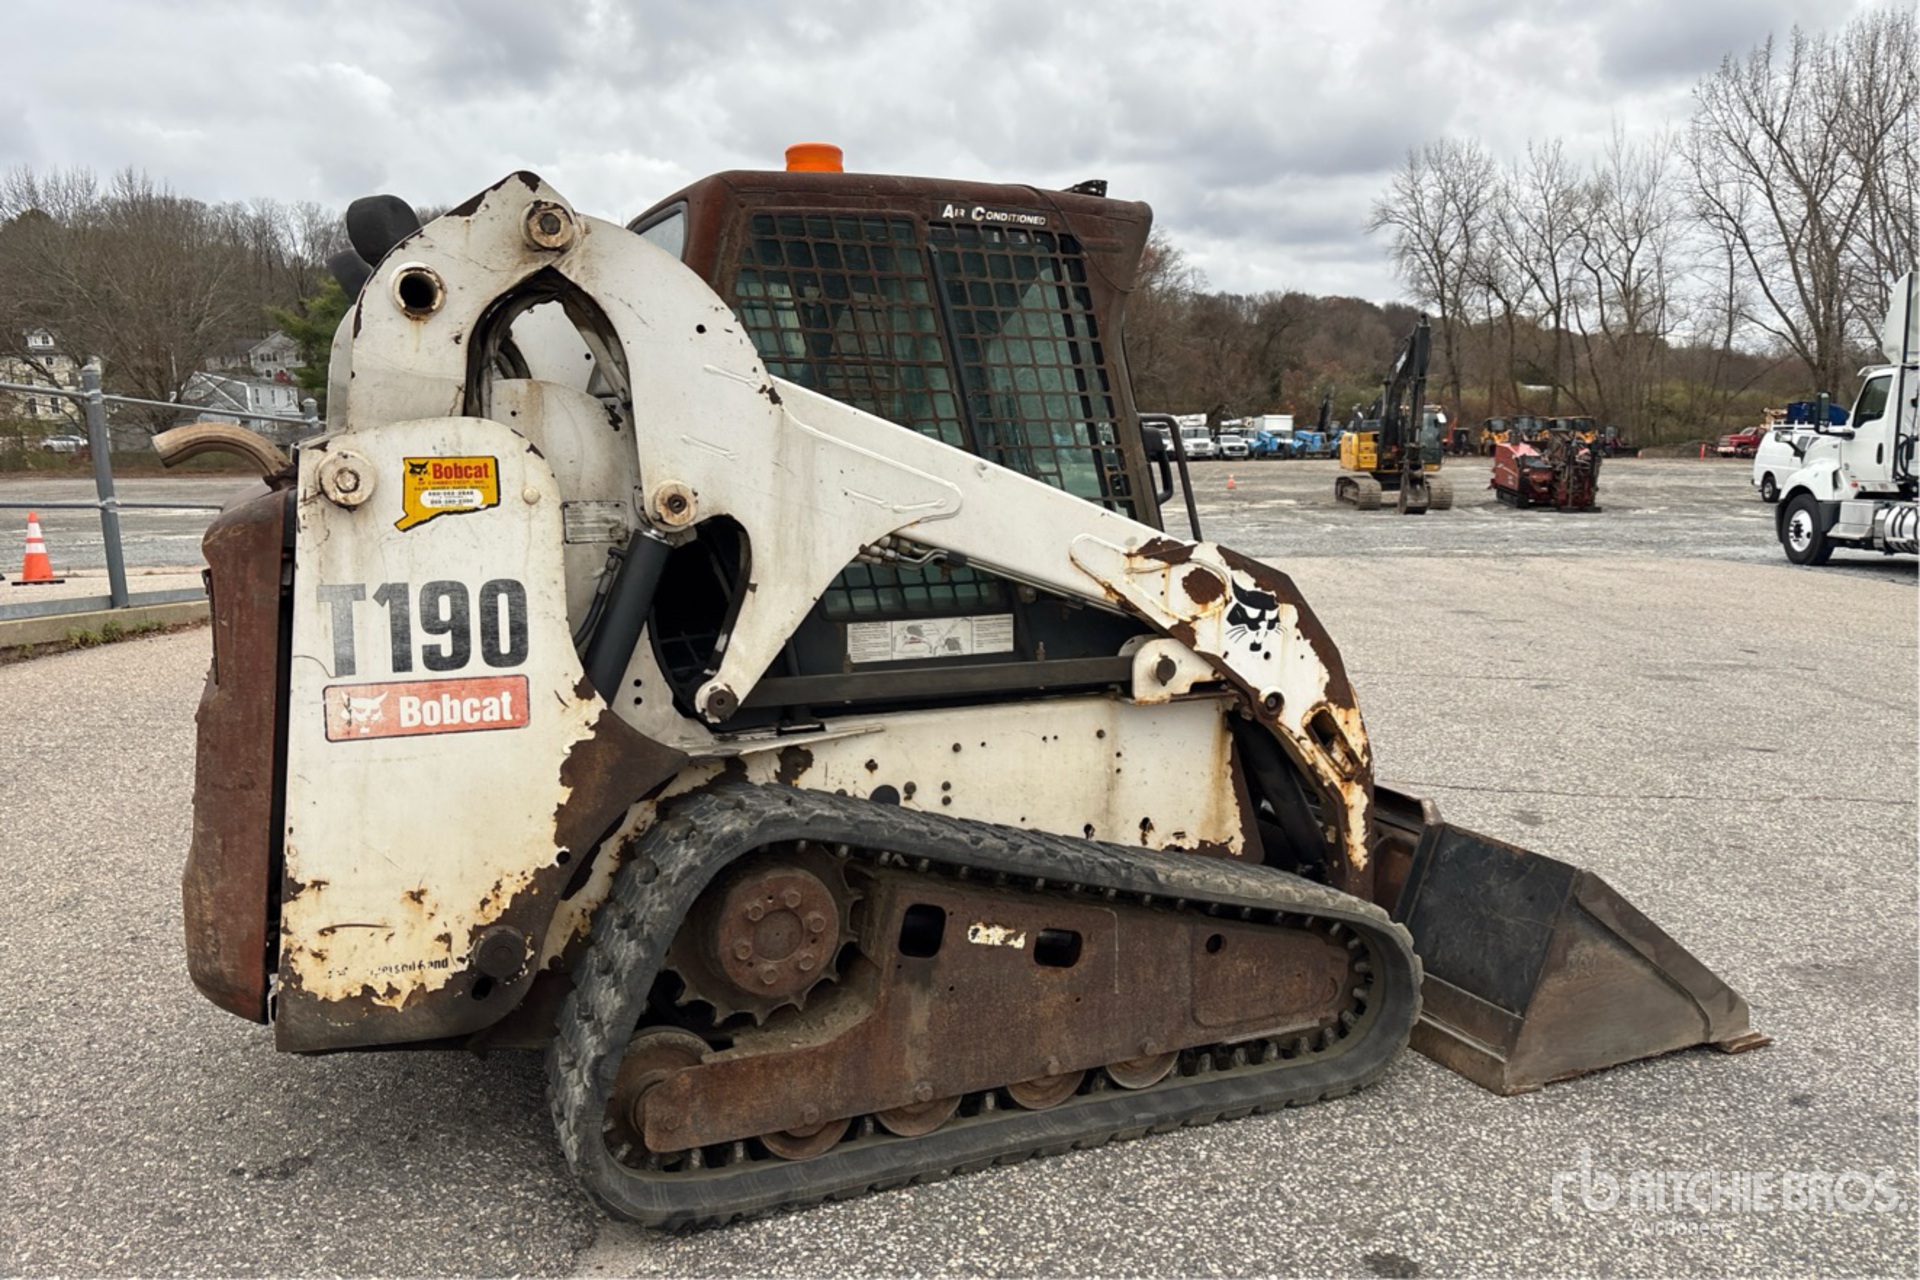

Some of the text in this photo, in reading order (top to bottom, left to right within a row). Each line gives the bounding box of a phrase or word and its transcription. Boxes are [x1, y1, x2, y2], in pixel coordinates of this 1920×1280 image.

[942, 203, 1047, 226] AIR CONDITIONED
[432, 462, 490, 480] Bobcat
[316, 578, 530, 676] T190
[399, 690, 514, 728] Bobcat
